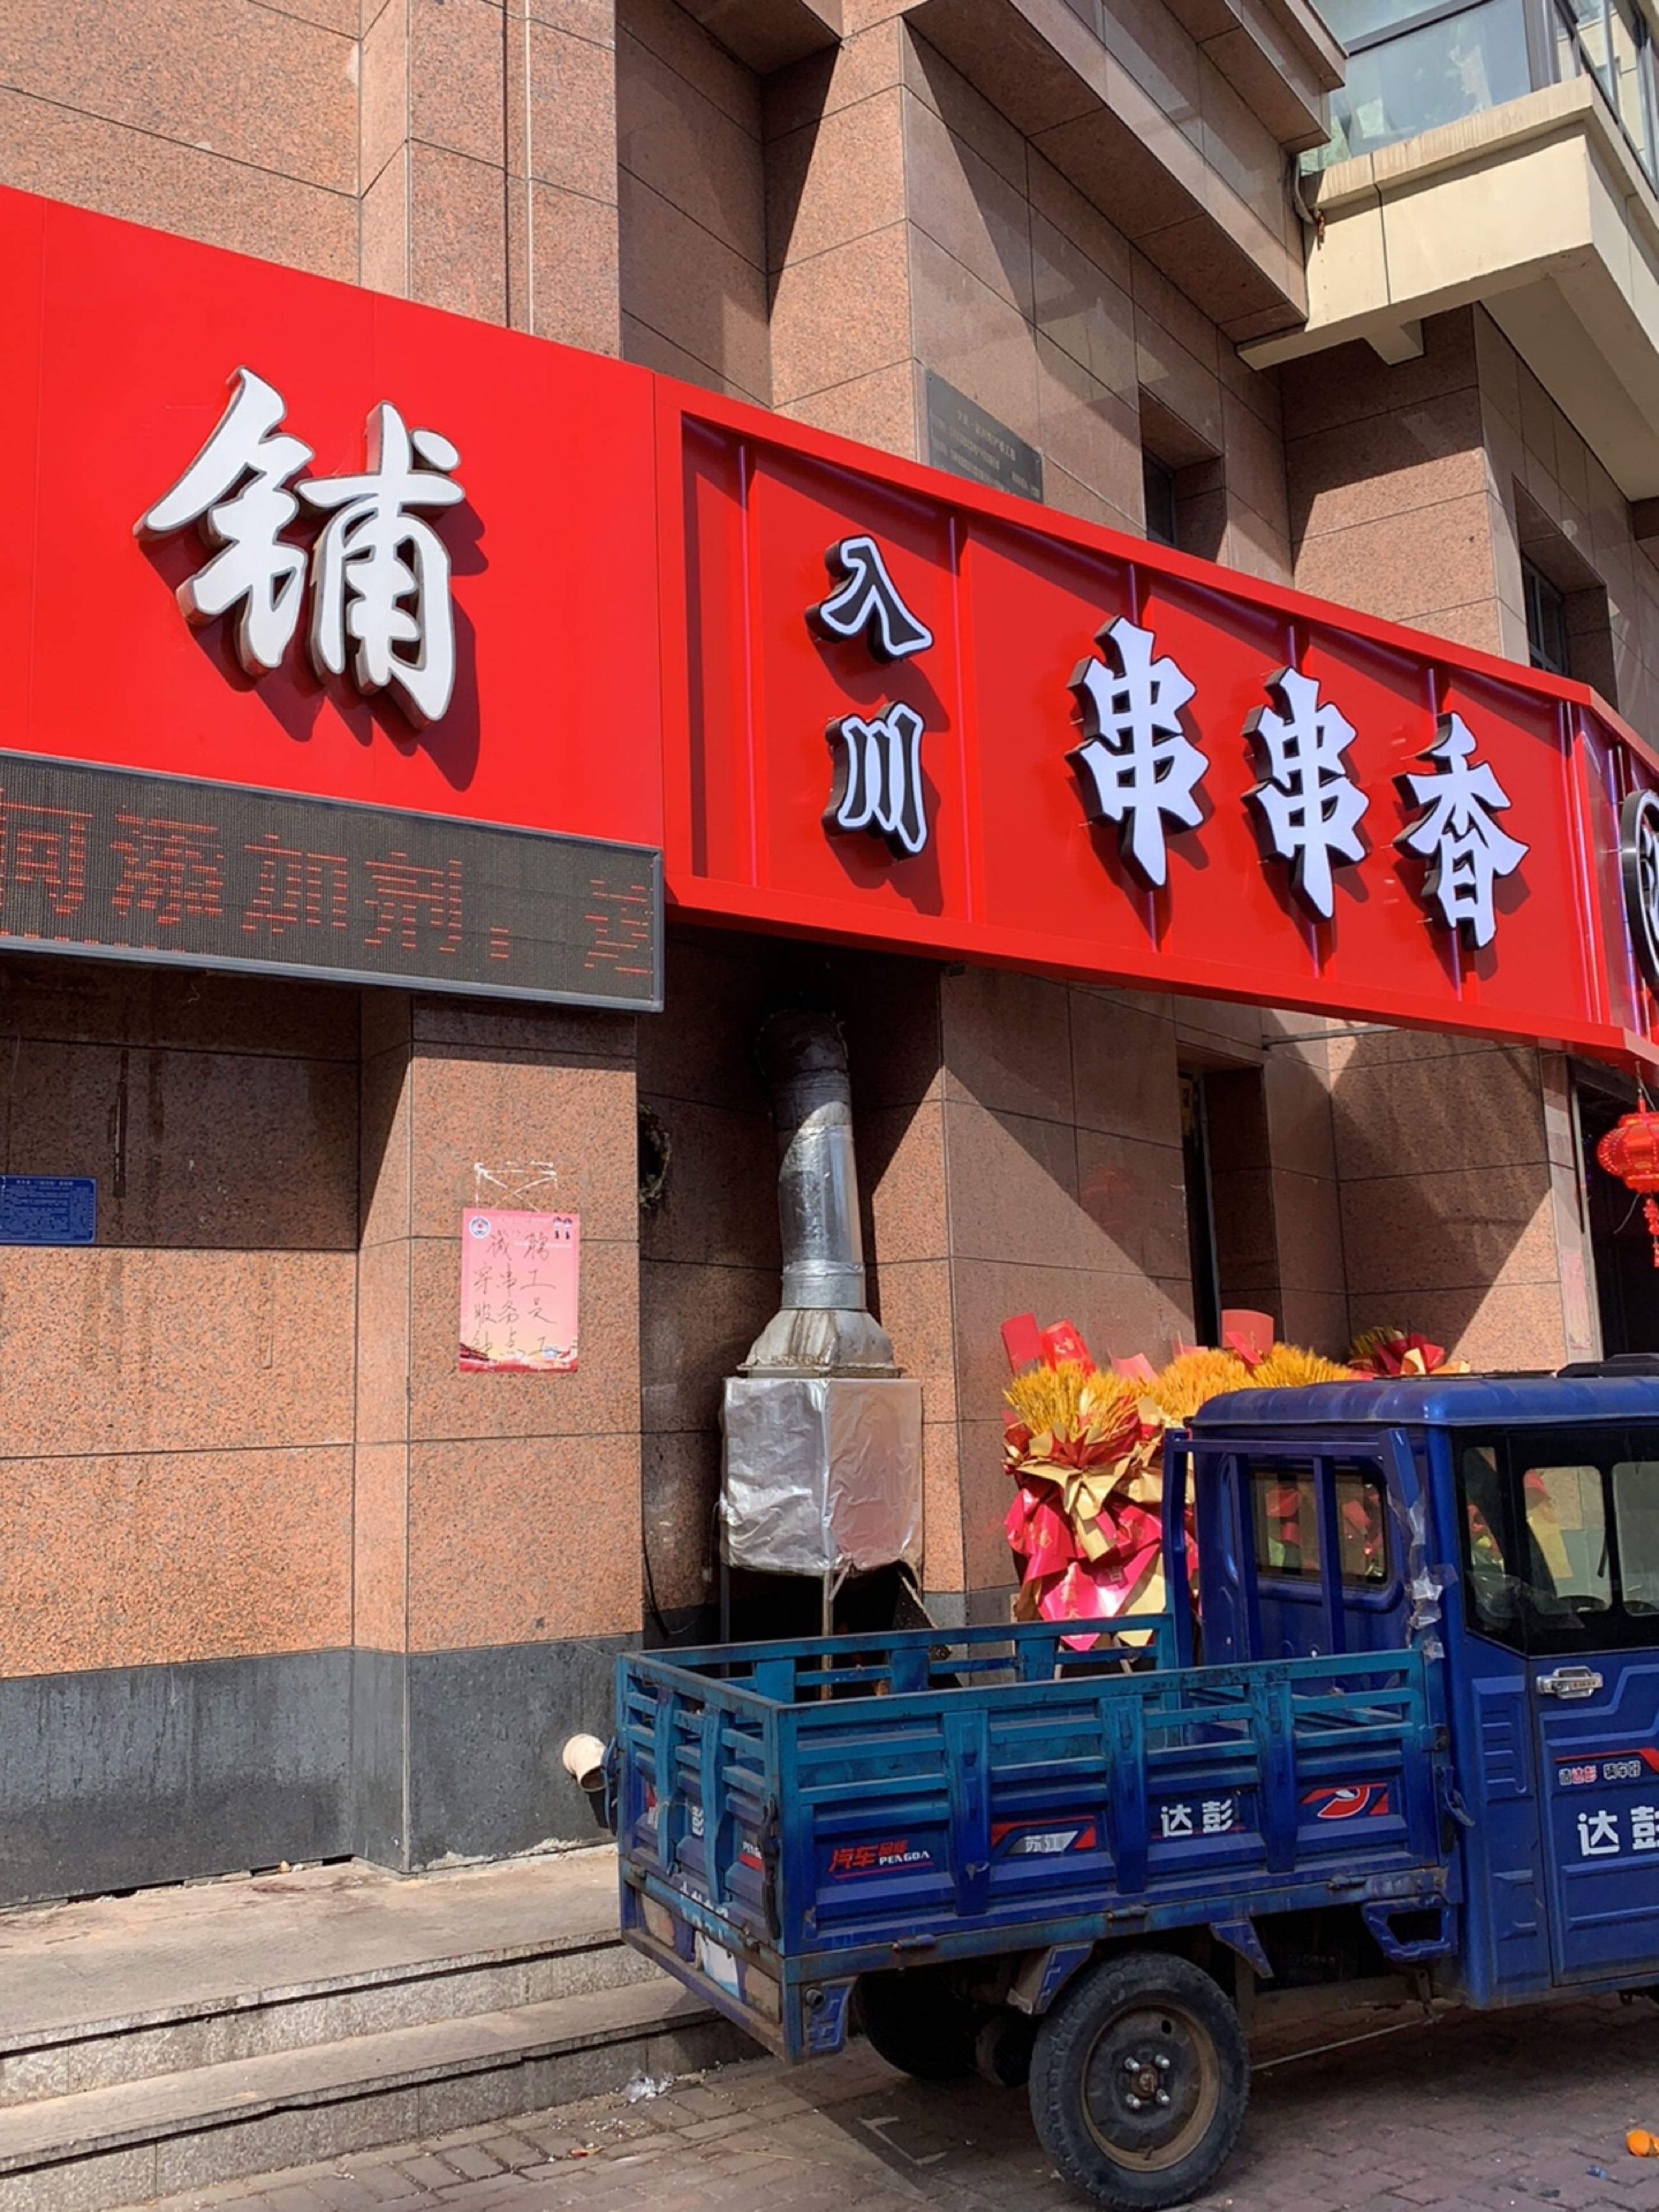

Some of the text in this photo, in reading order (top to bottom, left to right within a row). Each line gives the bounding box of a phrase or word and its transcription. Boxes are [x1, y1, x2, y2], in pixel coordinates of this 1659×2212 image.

[134, 365, 465, 725] 铺
[1065, 614, 1530, 950] 串串香
